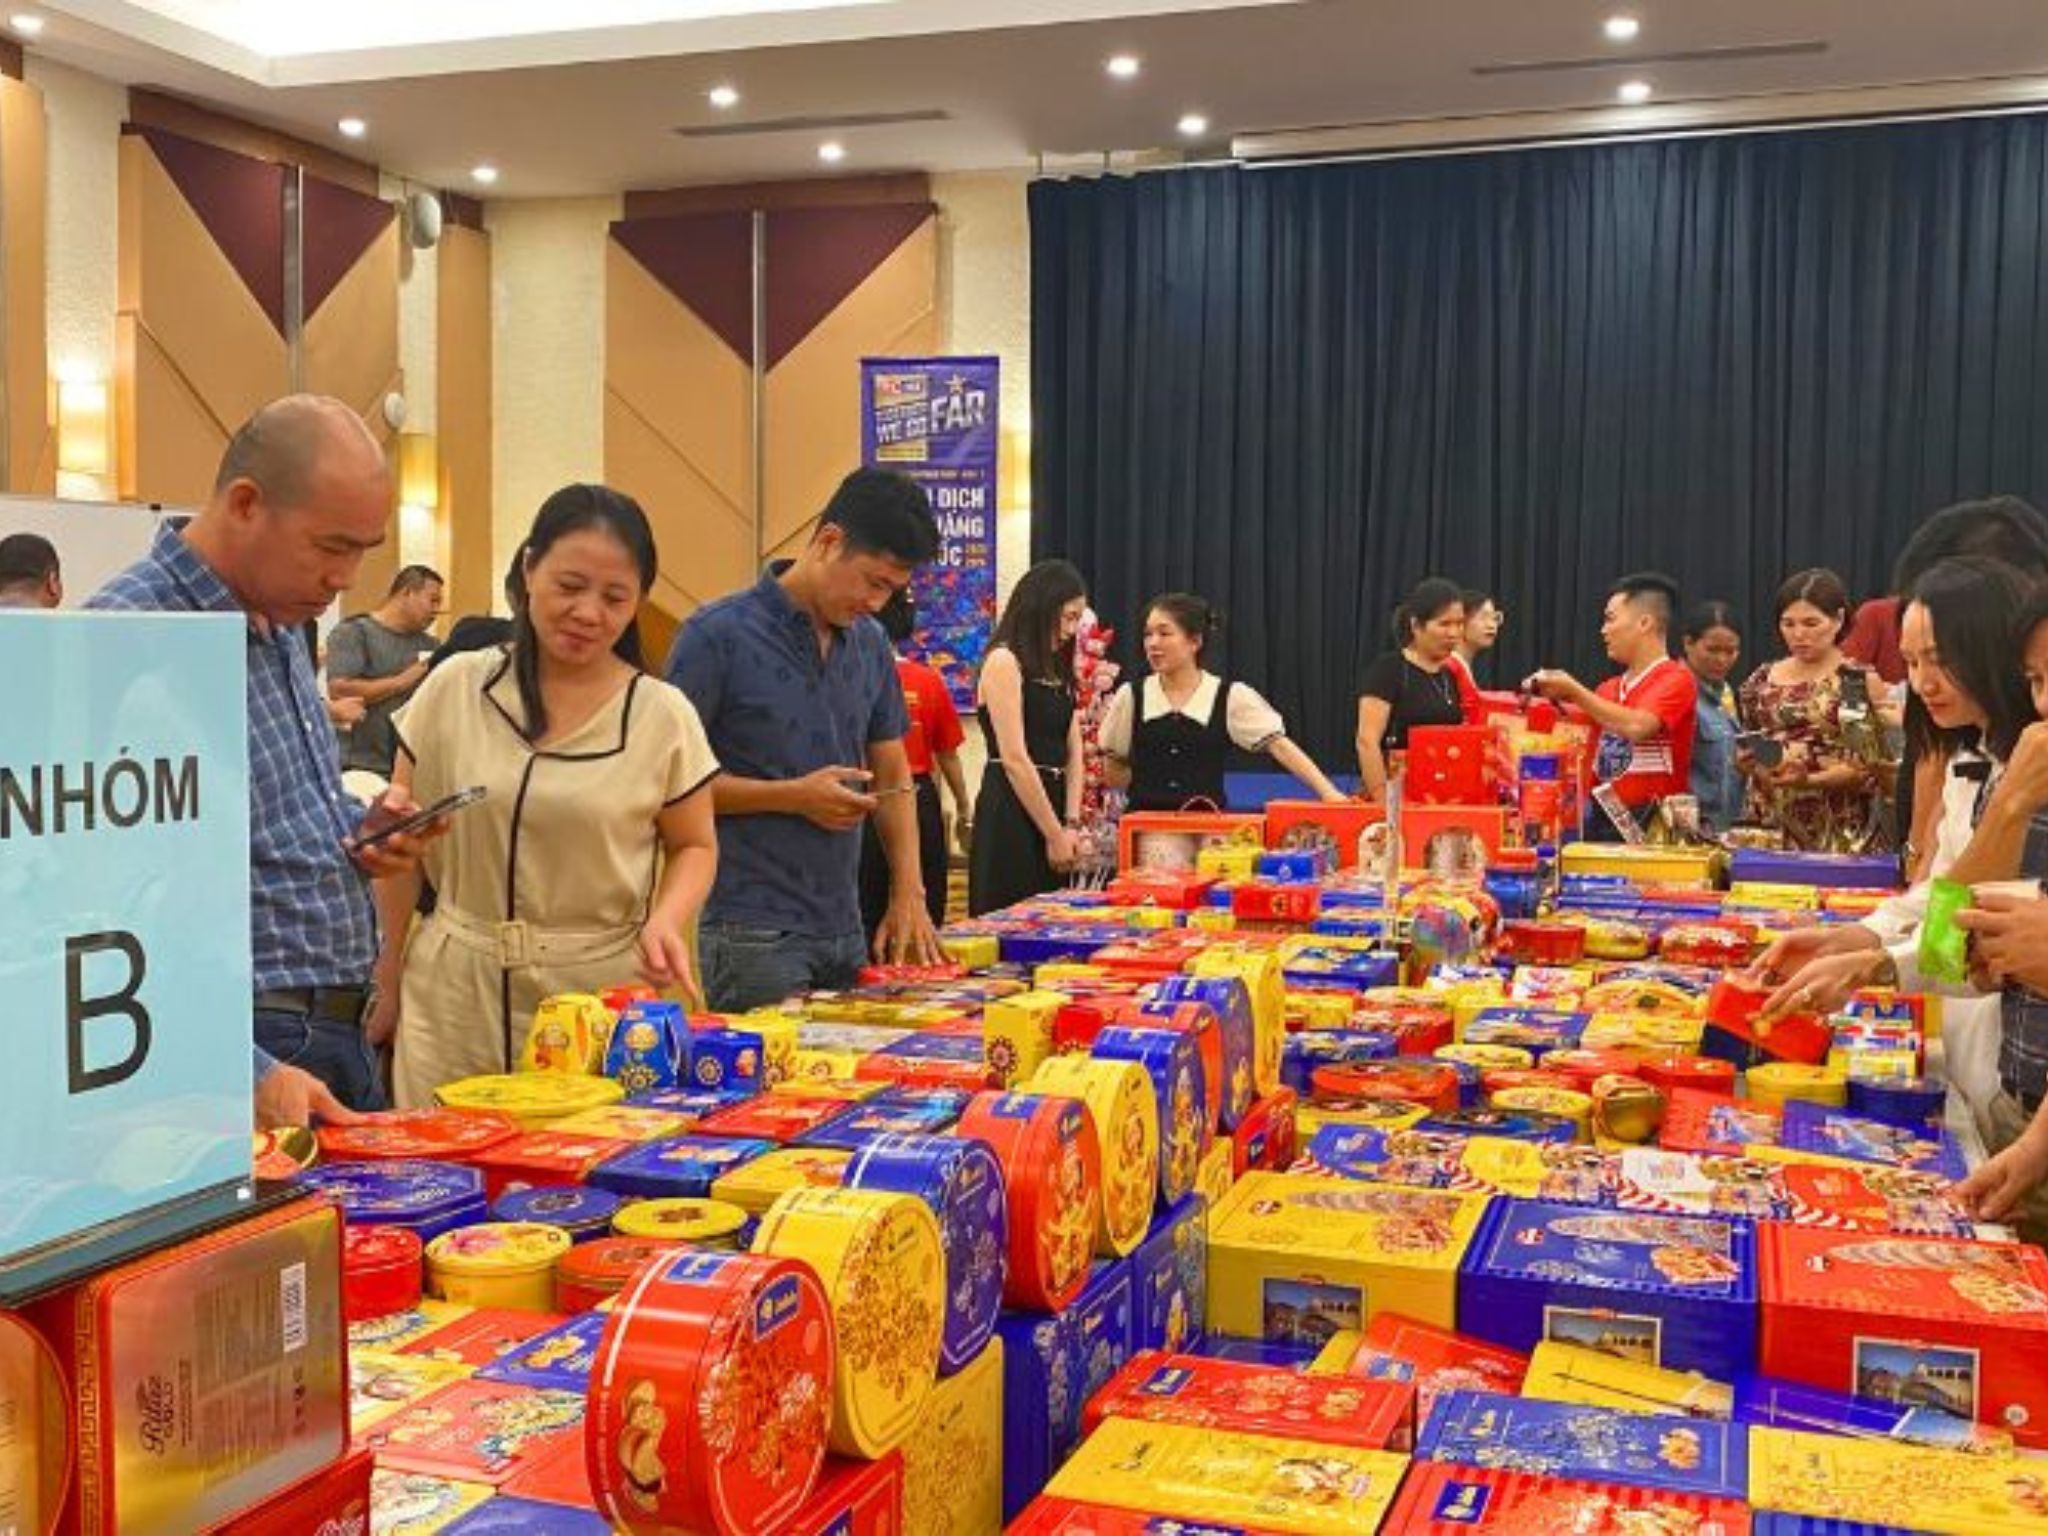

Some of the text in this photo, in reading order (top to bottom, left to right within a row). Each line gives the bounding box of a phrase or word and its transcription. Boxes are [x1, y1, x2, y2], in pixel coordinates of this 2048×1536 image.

[931, 388, 985, 434] FAR
[0, 746, 199, 839] NHÓM
[65, 930, 152, 1095] B
